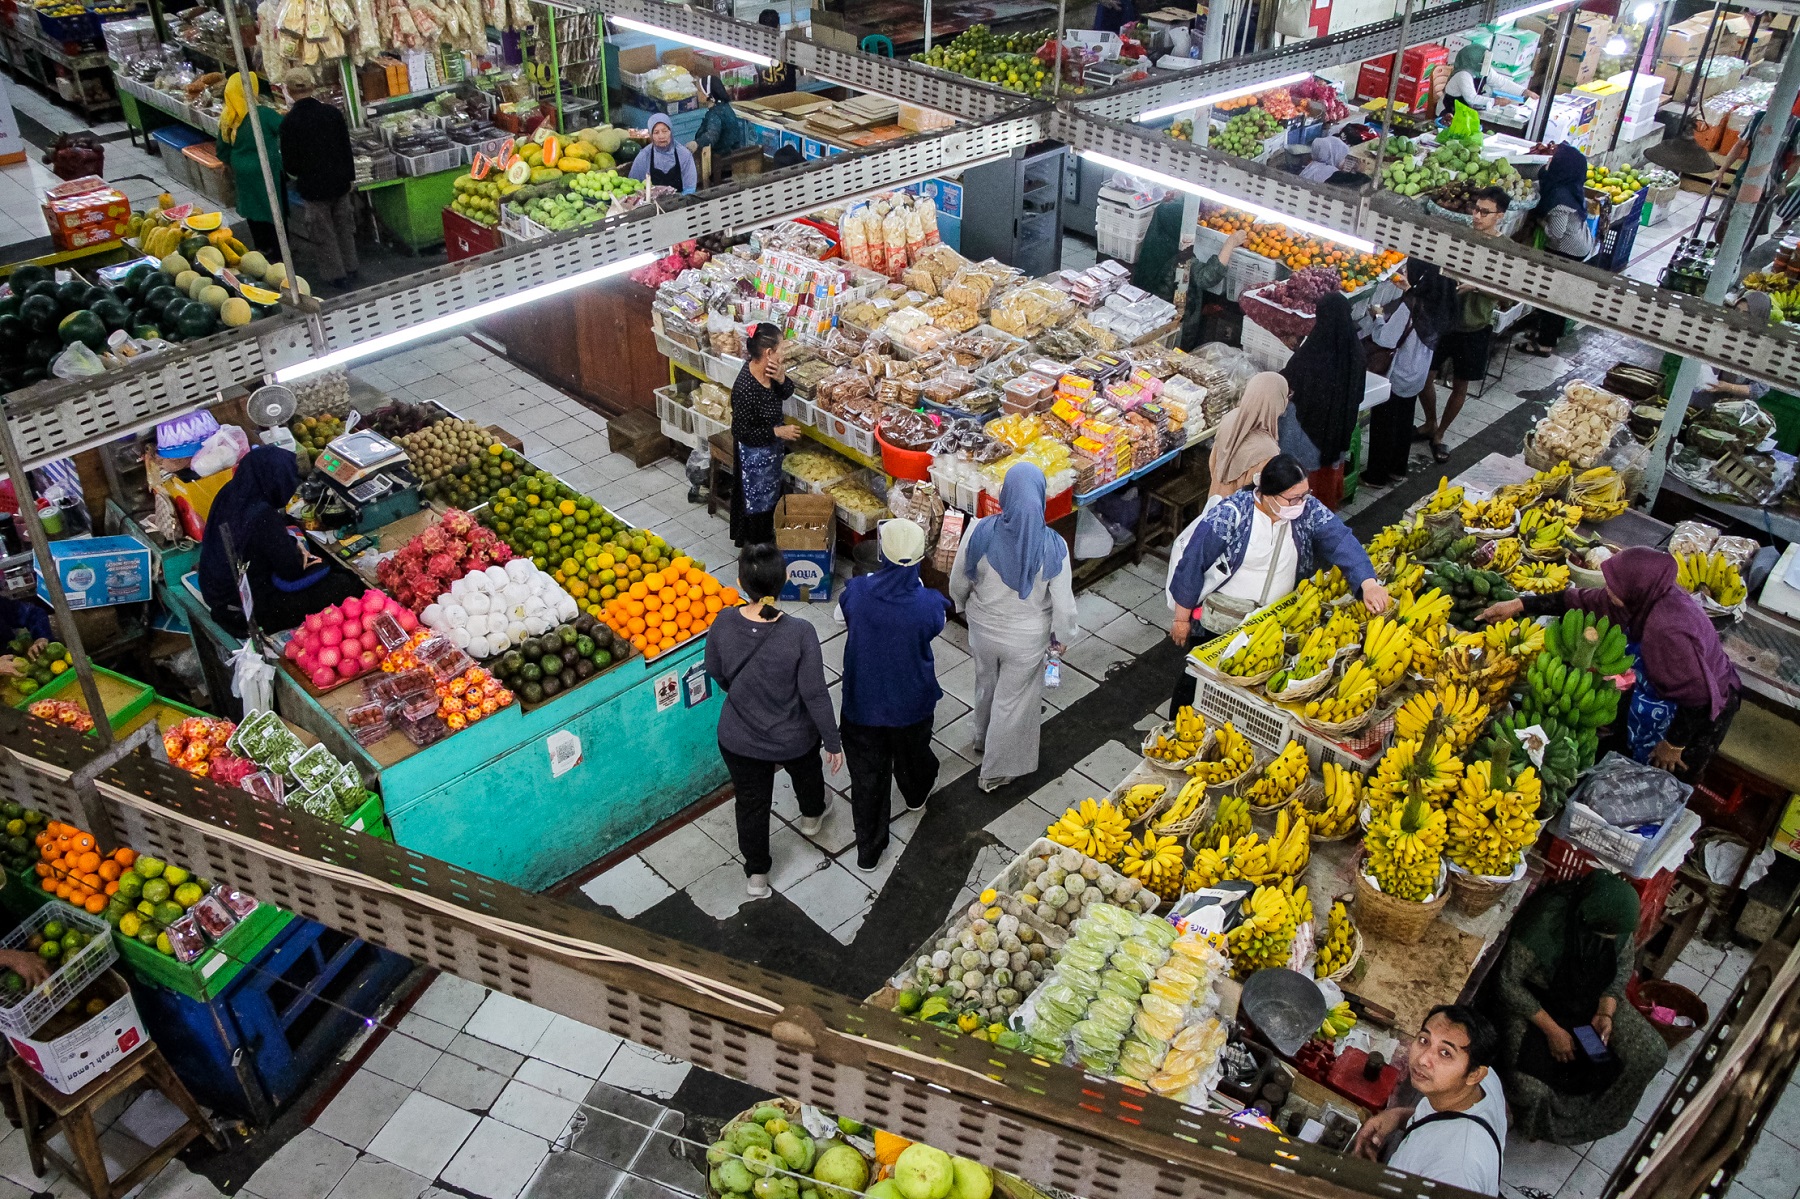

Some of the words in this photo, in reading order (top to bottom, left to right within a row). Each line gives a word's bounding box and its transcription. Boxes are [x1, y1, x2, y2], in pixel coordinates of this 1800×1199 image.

[791, 570, 817, 579] AQUA
[96, 1044, 120, 1064] Fresh
[67, 1062, 96, 1081] Lemon
